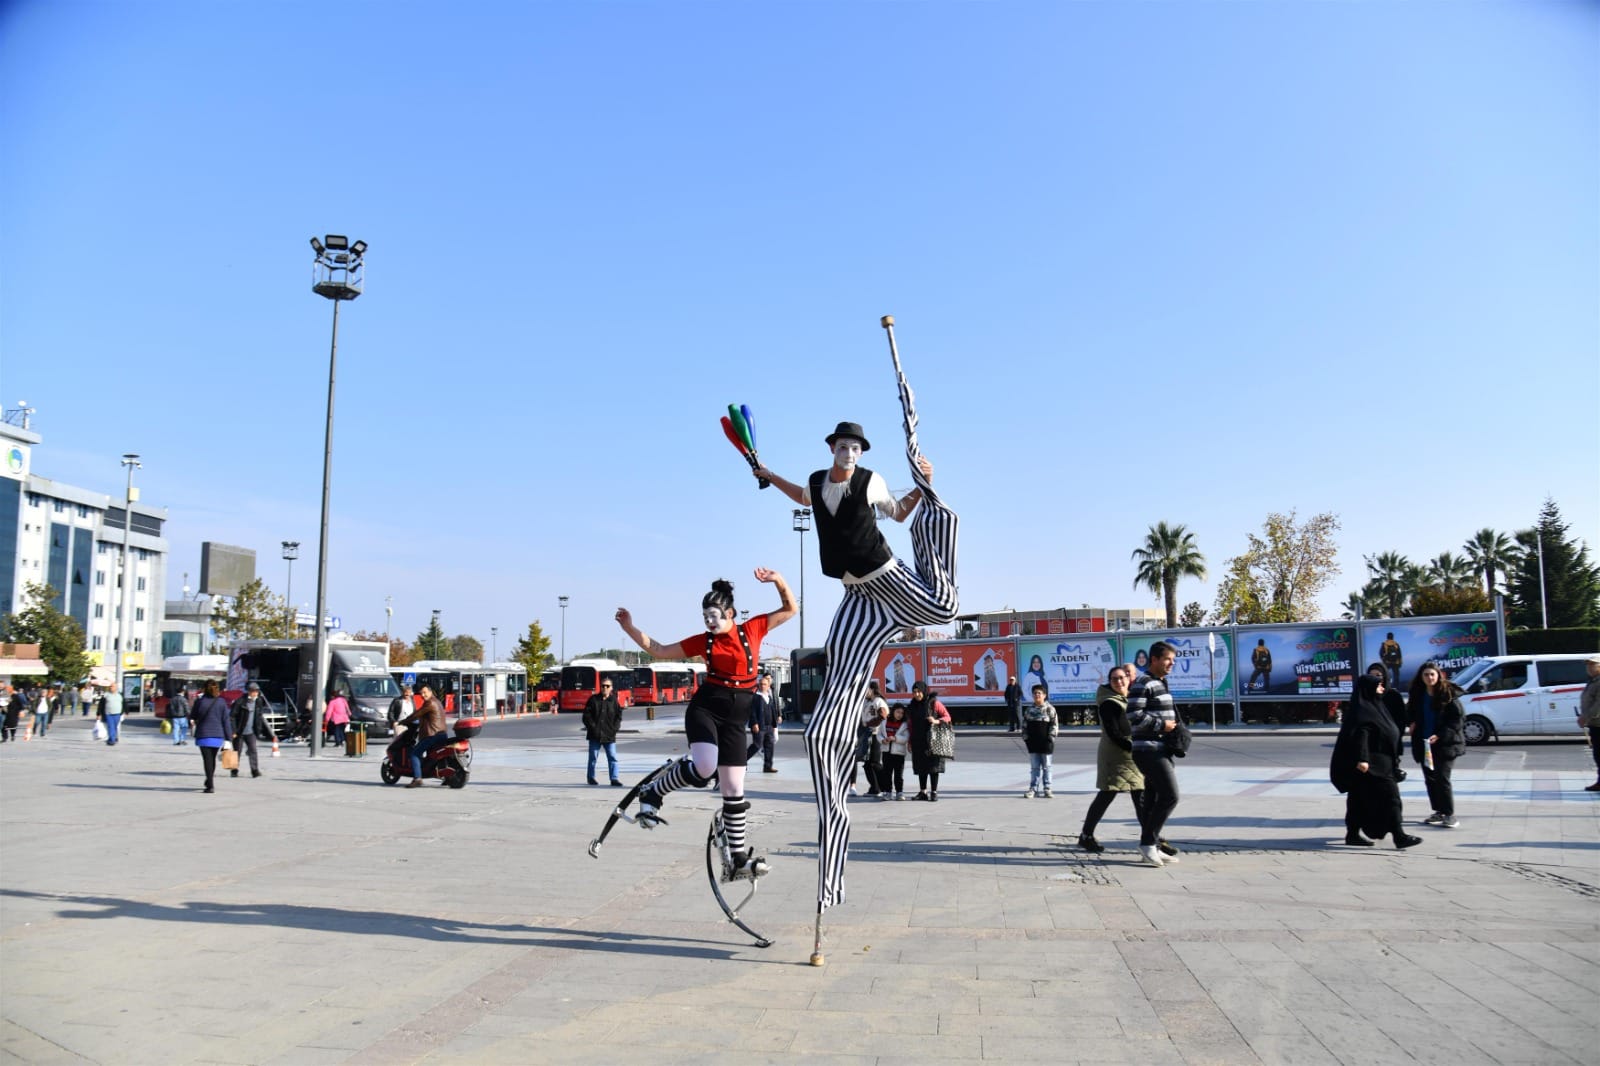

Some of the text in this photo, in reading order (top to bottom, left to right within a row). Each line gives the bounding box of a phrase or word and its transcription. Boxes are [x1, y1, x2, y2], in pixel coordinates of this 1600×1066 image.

[1176, 649, 1200, 657] DENT
[1448, 646, 1477, 659] ARTIK
[931, 656, 963, 667] Koçtaş
[1050, 655, 1090, 663] ATADENT
[931, 667, 952, 675] şimdi
[1295, 660, 1351, 674] HİZMETİNİZDE
